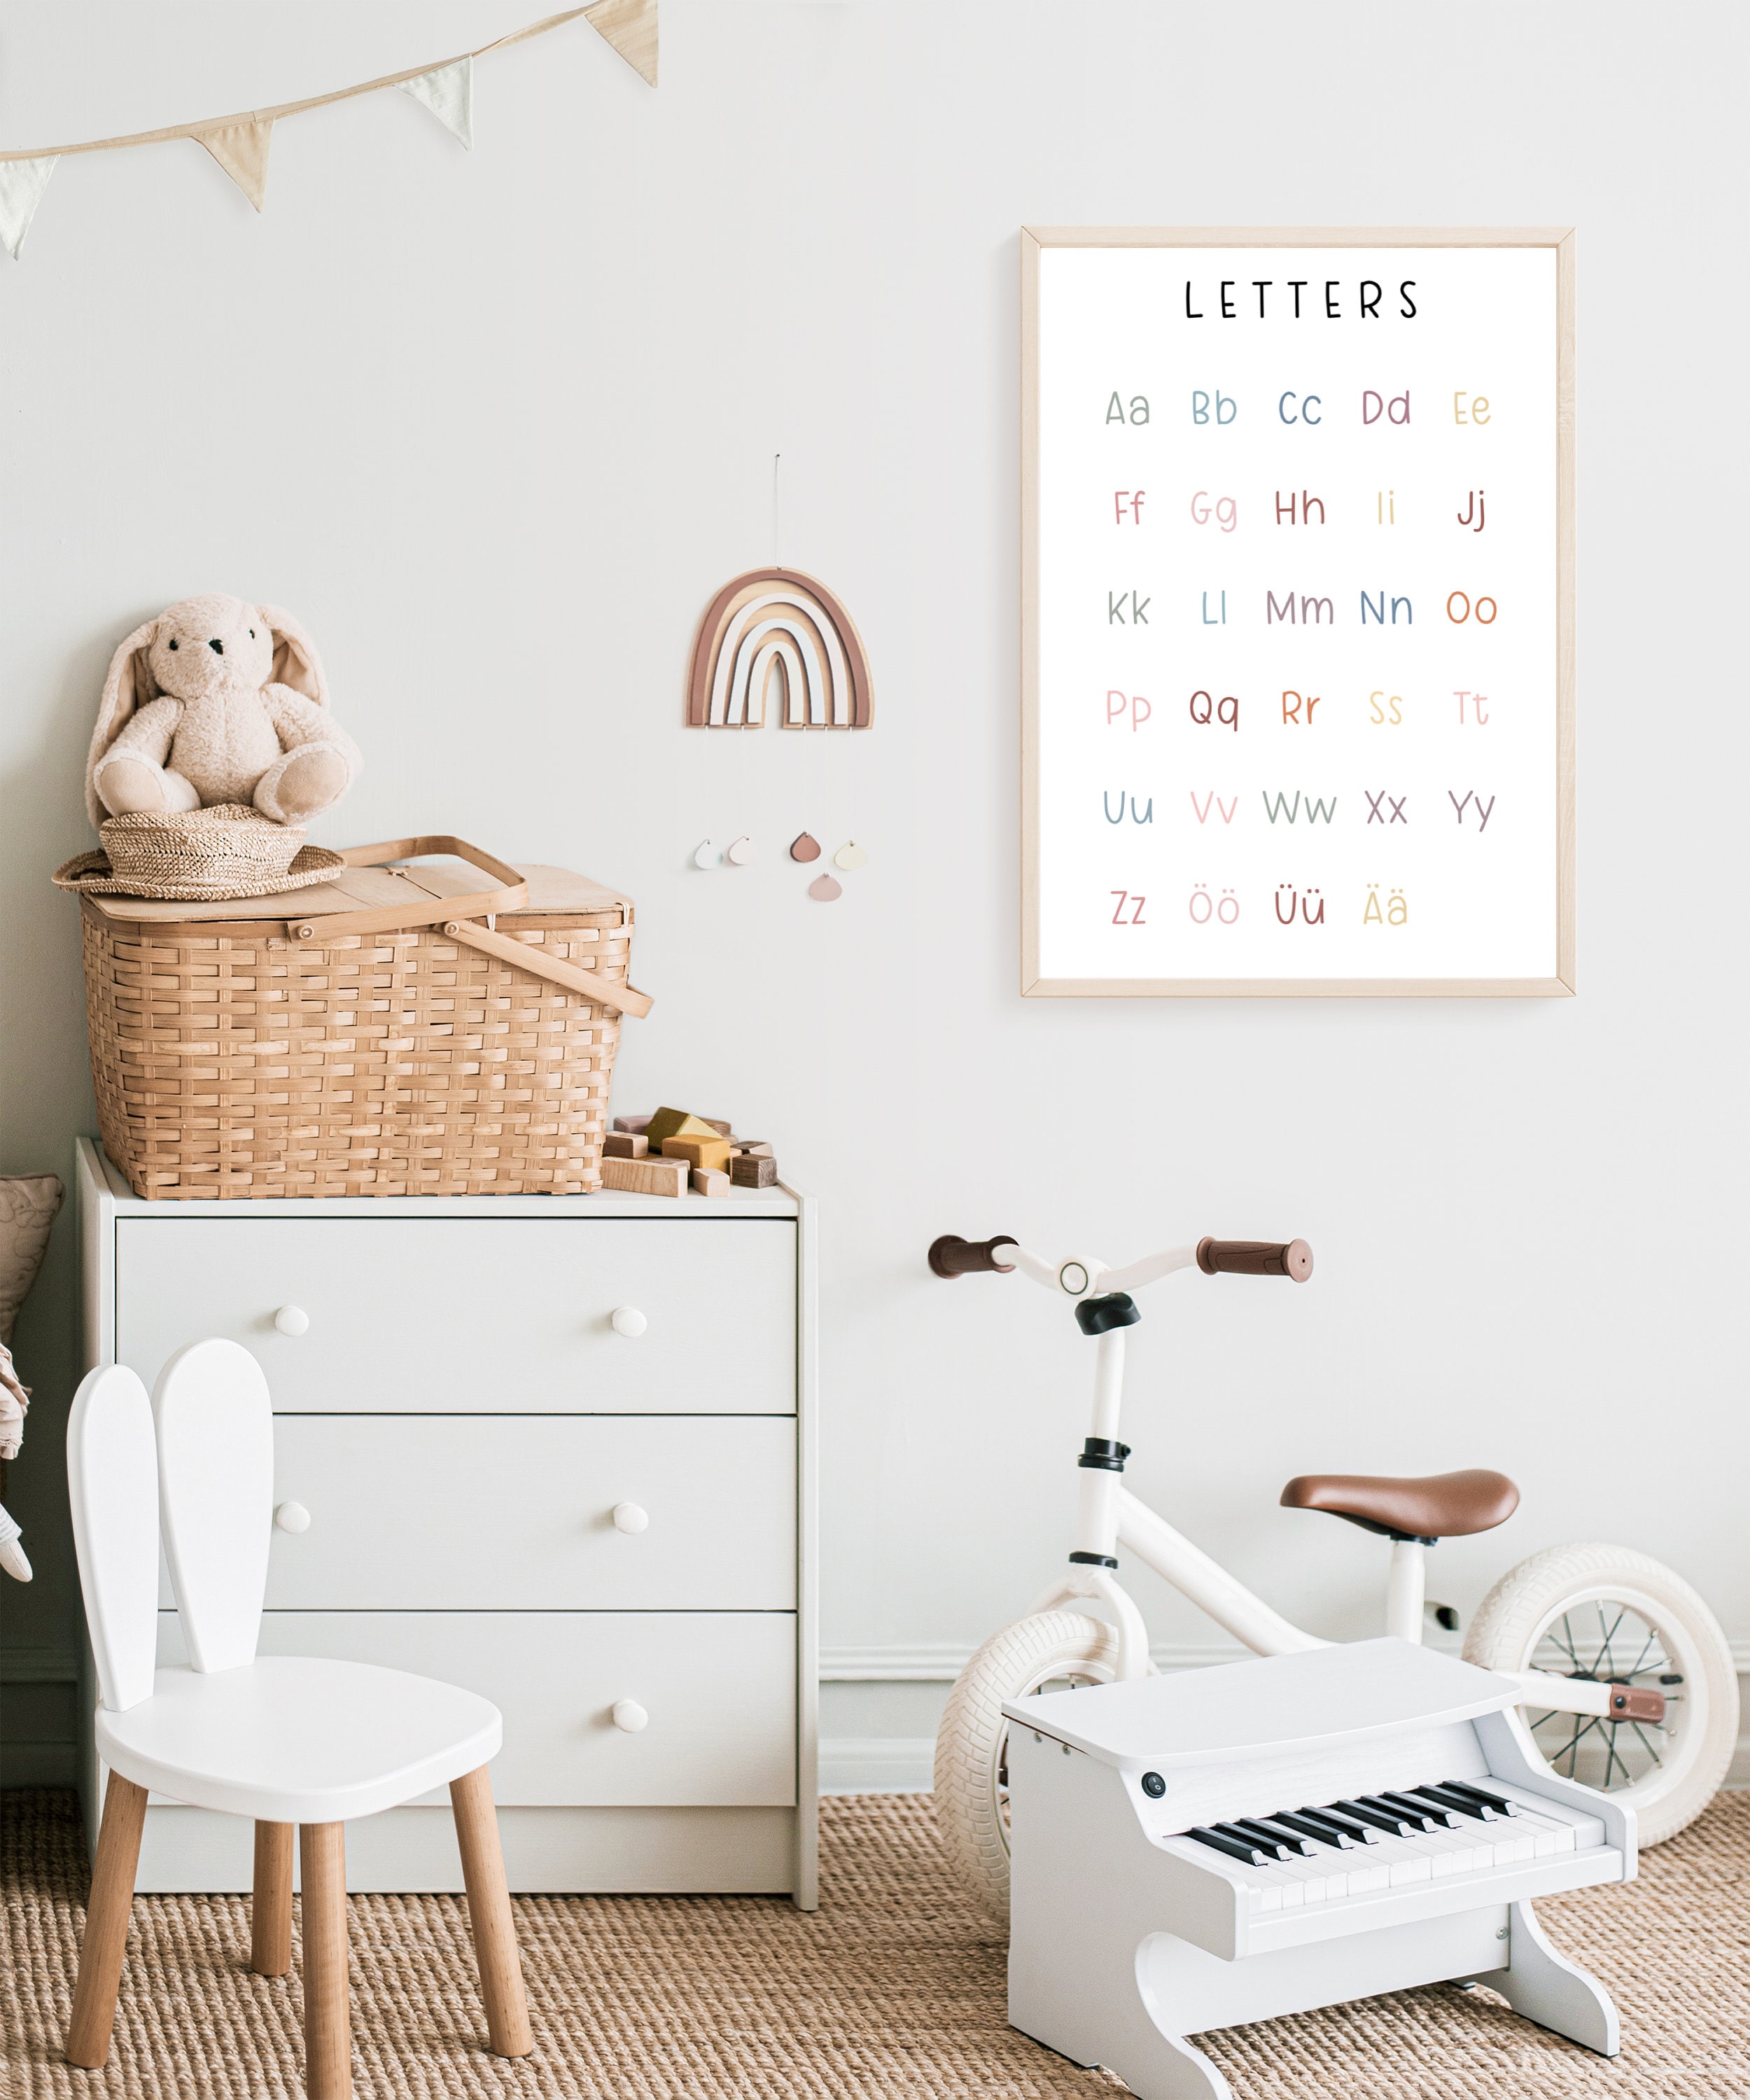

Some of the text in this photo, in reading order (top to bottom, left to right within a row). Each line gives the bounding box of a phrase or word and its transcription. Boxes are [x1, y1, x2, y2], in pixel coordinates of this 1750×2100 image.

[1186, 280, 1417, 318] LETTERS
[1106, 389, 1491, 426] Aa Bb Cc Dd Ee
[1115, 491, 1145, 525] Ff
[1191, 491, 1236, 533] Gg
[1275, 490, 1325, 525] Hh
[1457, 490, 1485, 533] Jj
[1109, 590, 1151, 624] Kk
[1267, 591, 1334, 624] Mm
[1361, 591, 1412, 624] Nn
[1446, 591, 1497, 624] Oo
[1107, 690, 1488, 732] Pp Qq Rr Ss Tt
[1104, 790, 1495, 832] Uu Vv Ww Xx Yy
[1110, 883, 1407, 926] Zz Öö Üü Ää
